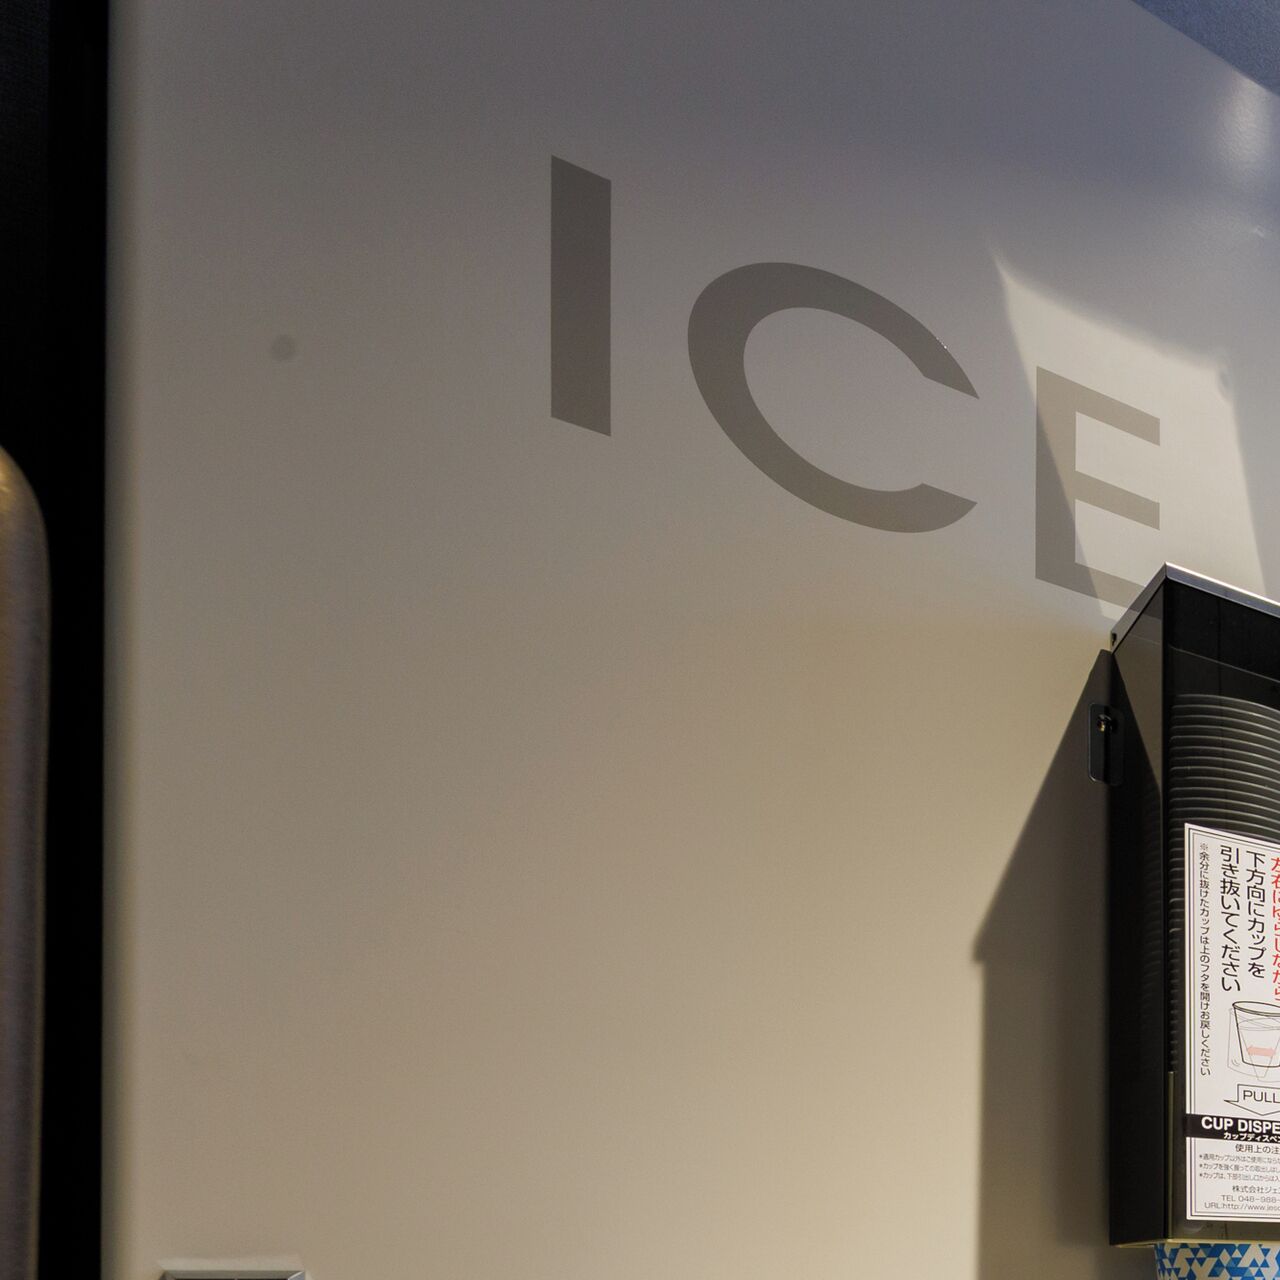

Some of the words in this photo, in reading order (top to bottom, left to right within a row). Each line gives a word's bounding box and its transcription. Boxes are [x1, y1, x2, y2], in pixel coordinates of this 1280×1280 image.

[551, 155, 1160, 609] ICE
[1220, 845, 1241, 991] 引き抜いてください
[1246, 851, 1265, 978] 下方向にカップを
[1201, 1117, 1233, 1130] CUP
[1243, 1090, 1280, 1103] PULL
